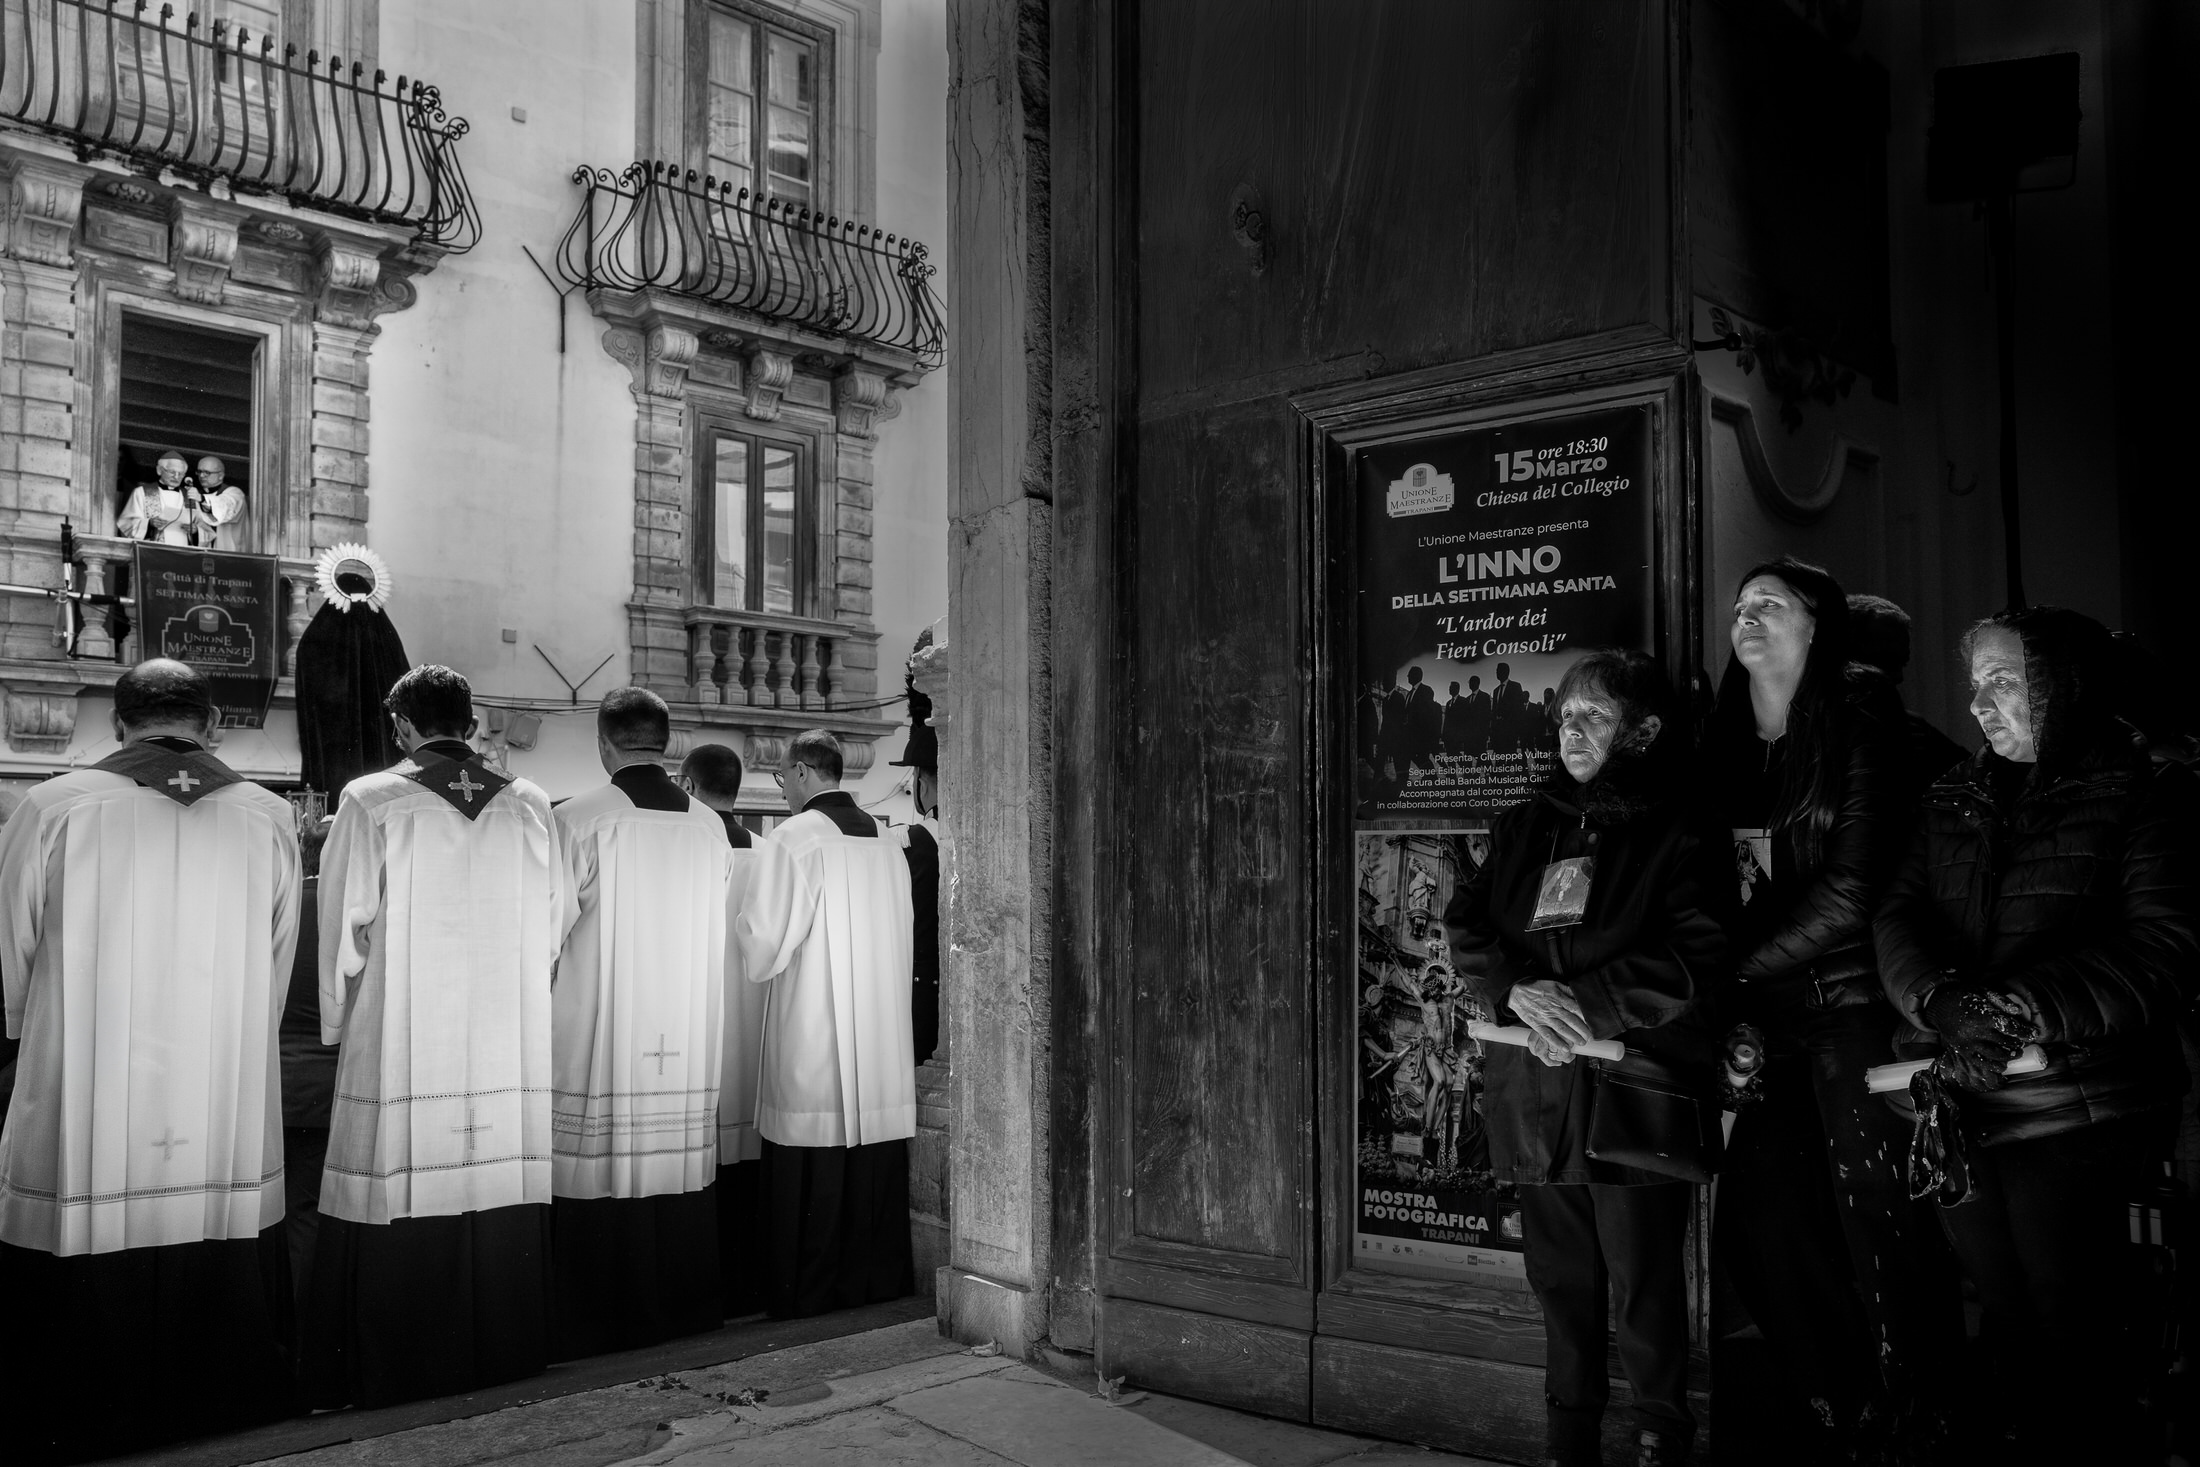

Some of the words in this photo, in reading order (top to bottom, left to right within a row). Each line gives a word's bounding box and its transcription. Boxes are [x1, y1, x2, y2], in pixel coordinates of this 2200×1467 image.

[1538, 445, 1563, 460] ore
[1566, 437, 1608, 456] 18:30
[1495, 450, 1535, 484] 15
[1536, 456, 1607, 479] Marzo
[1476, 489, 1528, 508] Chiesa
[1532, 485, 1557, 501] del
[1561, 475, 1630, 499] Collegio
[1390, 493, 1452, 511] MAESTRANZE
[1407, 506, 1434, 515] TRAPANI
[1468, 524, 1535, 543] Maestranze
[1537, 518, 1590, 536] presenta
[1439, 545, 1562, 584] L'INNO
[162, 571, 191, 584] Città
[194, 574, 206, 584] di
[209, 576, 252, 589] Trapani
[155, 588, 220, 603] SETTIMANA
[223, 593, 258, 605] SANTA
[1392, 588, 1445, 610] DELLA
[1448, 581, 1549, 604] SETTIMANA
[1553, 575, 1616, 595] SANTA
[1519, 607, 1548, 629] dei
[191, 655, 227, 664] TRAPANI
[1435, 641, 1478, 661] Fieri
[1434, 753, 1473, 764] Presenta
[1480, 751, 1523, 764] Giuseppe
[1406, 779, 1412, 787] a
[1413, 779, 1433, 787] cura
[1434, 776, 1457, 786] della
[1458, 775, 1486, 786] Banda
[1488, 774, 1528, 785] Musicale
[1408, 767, 1436, 779] Segue
[1438, 765, 1482, 776] Esibizione
[1483, 763, 1523, 774] Musicale
[1399, 787, 1465, 799] Accompagnata
[1466, 786, 1481, 797] dal
[1482, 787, 1502, 796] coro
[1377, 800, 1385, 809] in
[1386, 798, 1449, 809] collaborazione
[1450, 800, 1467, 808] con
[1469, 799, 1489, 808] Coro
[1364, 1188, 1438, 1210] MOSTRA
[1364, 1204, 1489, 1231] FOTOGRAFICA
[1421, 1227, 1480, 1244] TRAPANI
